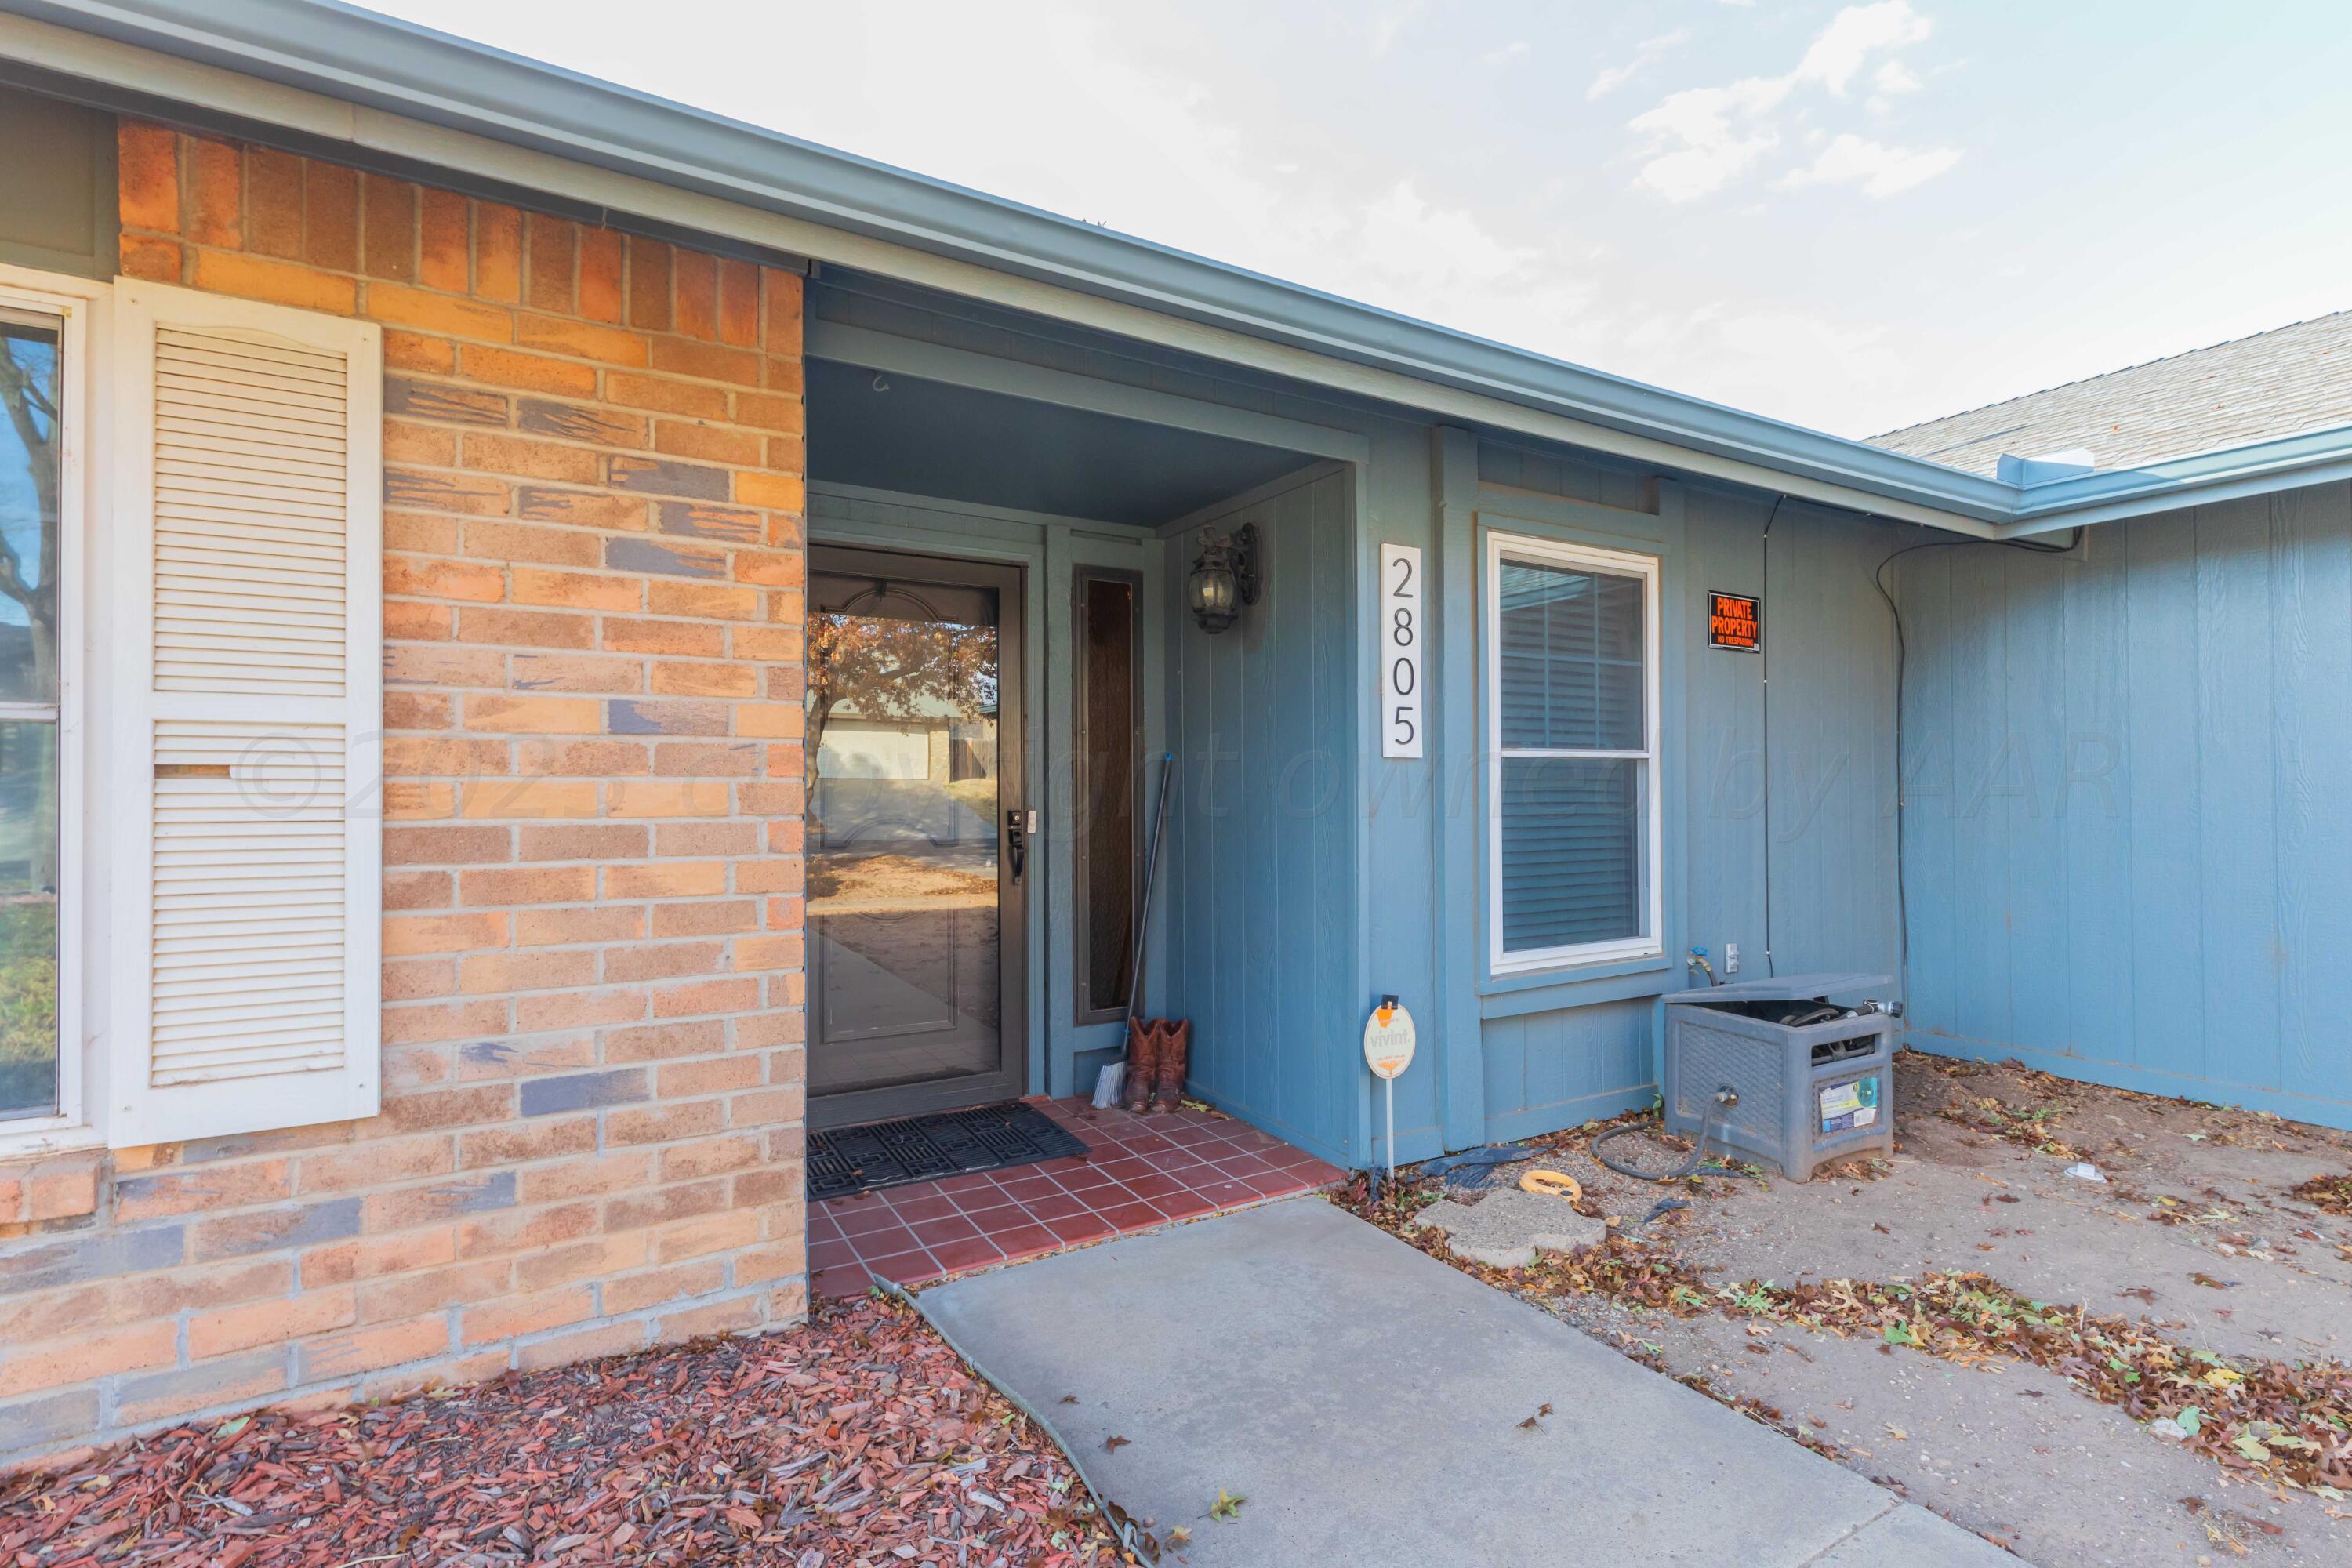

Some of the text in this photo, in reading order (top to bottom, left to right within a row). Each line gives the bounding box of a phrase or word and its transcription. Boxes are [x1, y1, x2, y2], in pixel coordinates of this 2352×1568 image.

[1717, 597, 1753, 619] PRIVATE
[1711, 615, 1758, 638] PROPERTY
[1392, 557, 1415, 746] 2805
[1718, 635, 1754, 647] NO TRESPASSING
